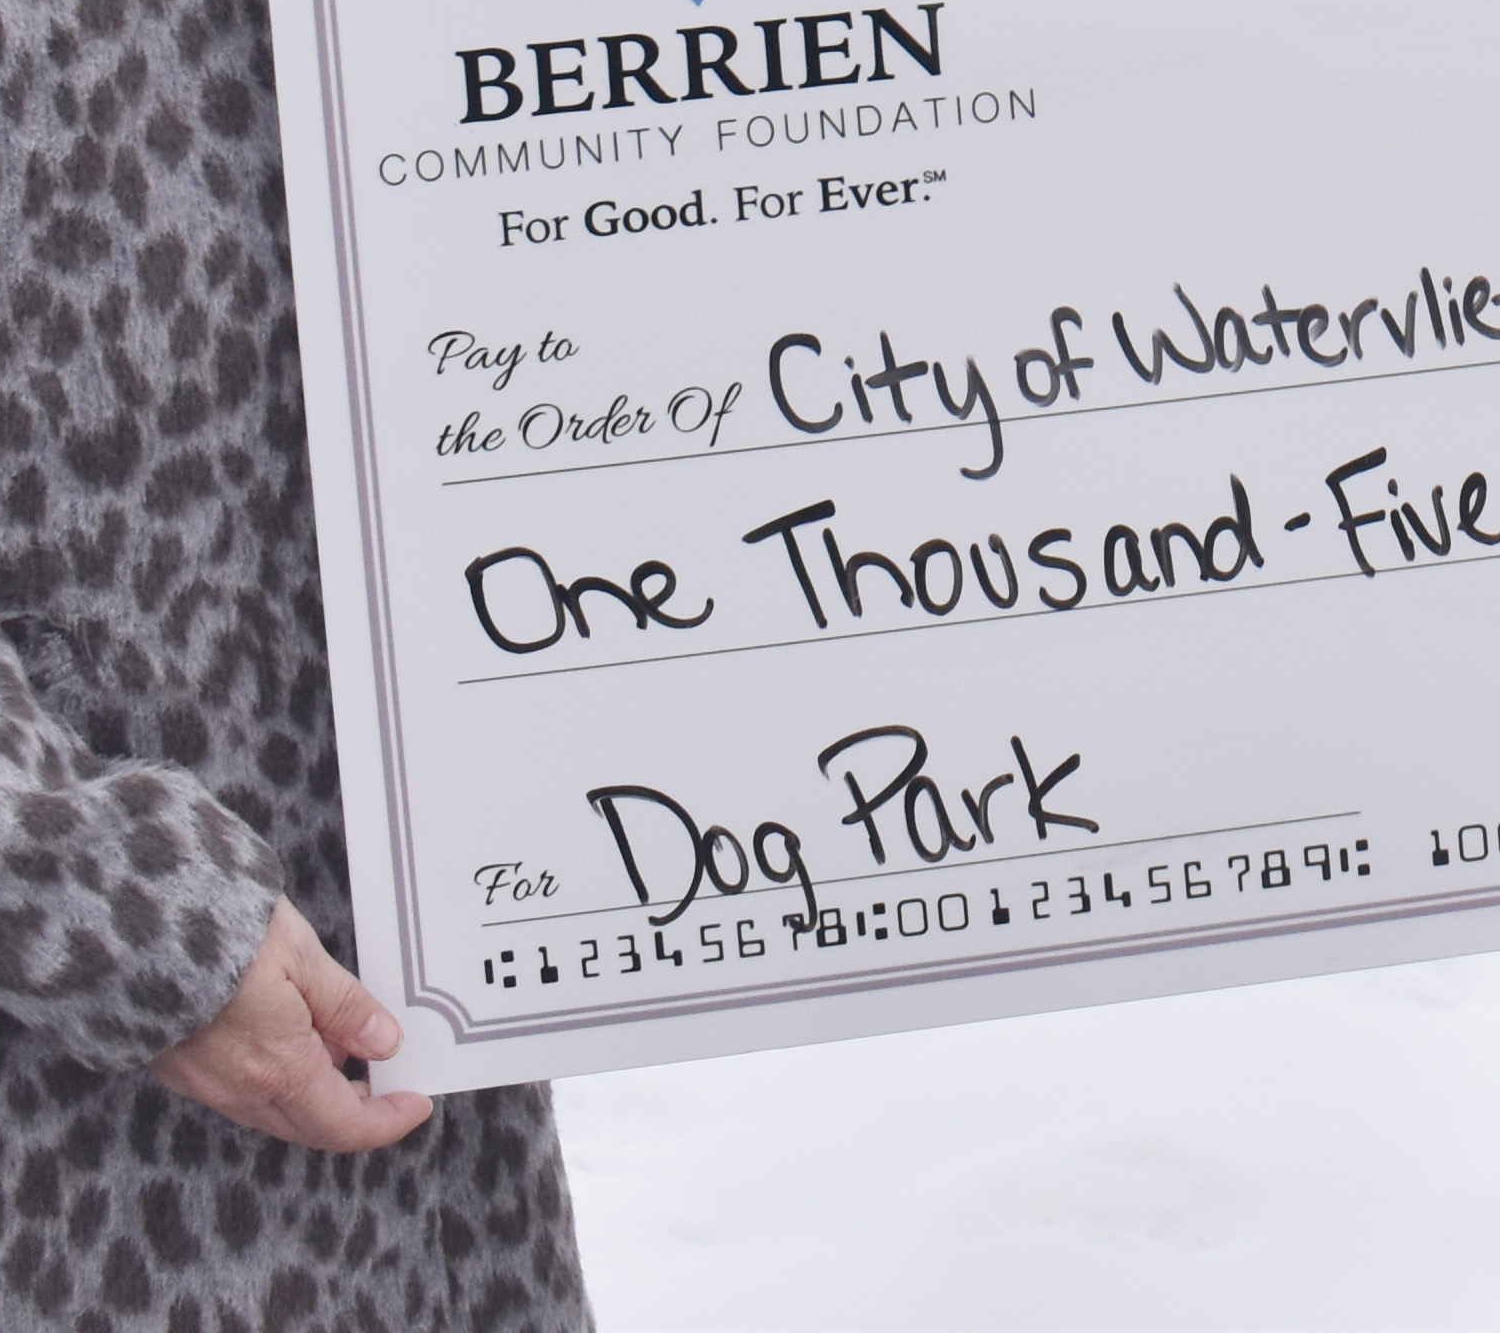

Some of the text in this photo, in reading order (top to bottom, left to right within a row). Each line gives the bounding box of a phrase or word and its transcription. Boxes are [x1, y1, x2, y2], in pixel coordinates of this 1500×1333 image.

[455, 2, 945, 125] BERRIEN
[379, 87, 1038, 186] COMMUNITY FOUNDATION
[498, 210, 570, 247] For
[584, 189, 718, 238] Good.
[734, 183, 803, 223] For
[427, 330, 580, 390] Pay to
[769, 332, 1004, 481] City
[1014, 305, 1095, 407] of
[436, 381, 743, 457] the Order Of
[465, 546, 715, 655] One
[586, 724, 1101, 933] Dog Park
[473, 861, 560, 905] For
